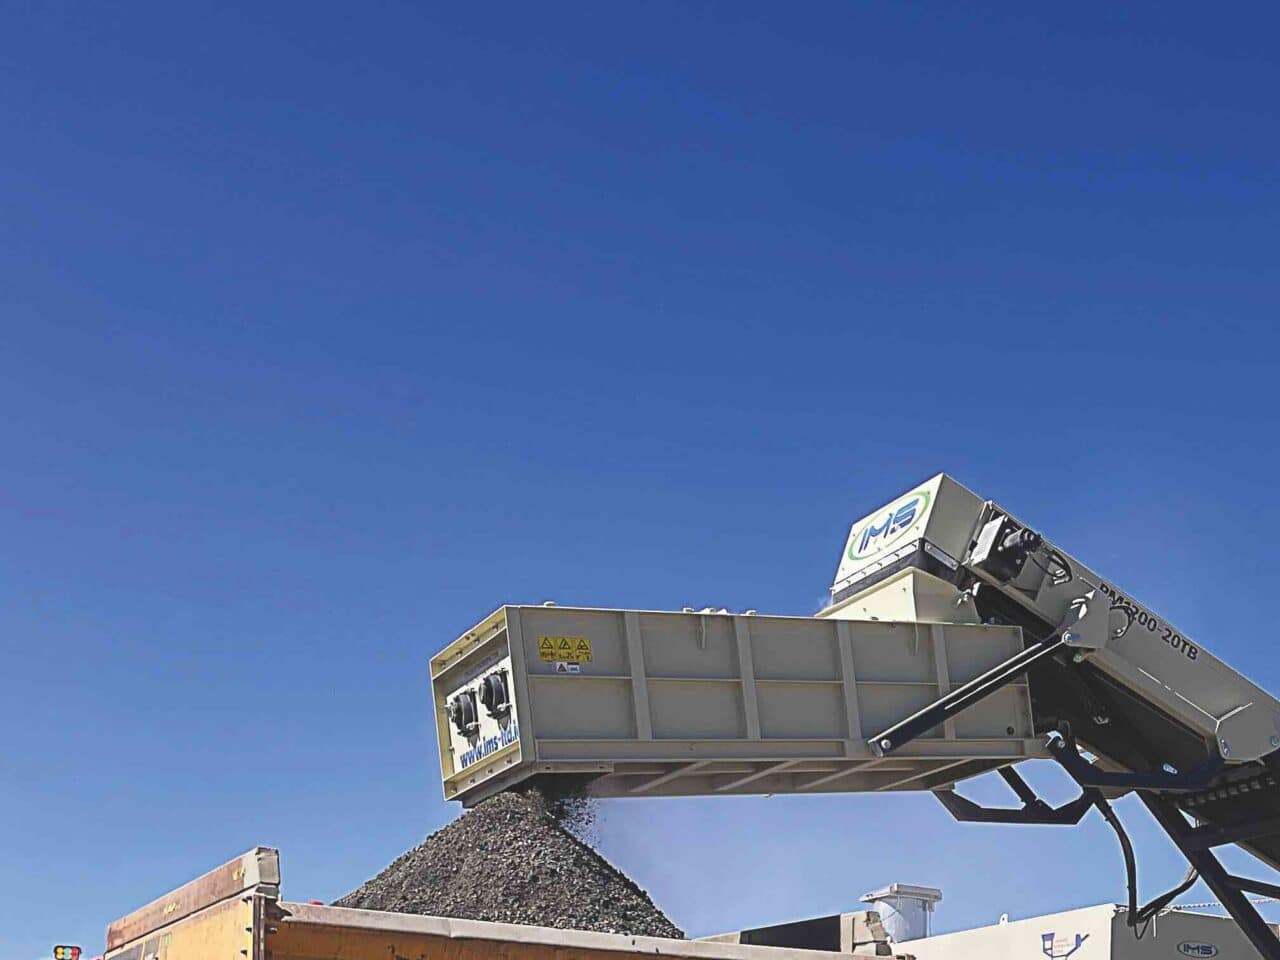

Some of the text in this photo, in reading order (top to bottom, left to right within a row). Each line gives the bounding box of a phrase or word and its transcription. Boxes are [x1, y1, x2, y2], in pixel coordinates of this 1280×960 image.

[858, 498, 920, 554] IMS
[459, 719, 520, 769] www.ims-ltd.i
[1183, 943, 1213, 955] IMS
